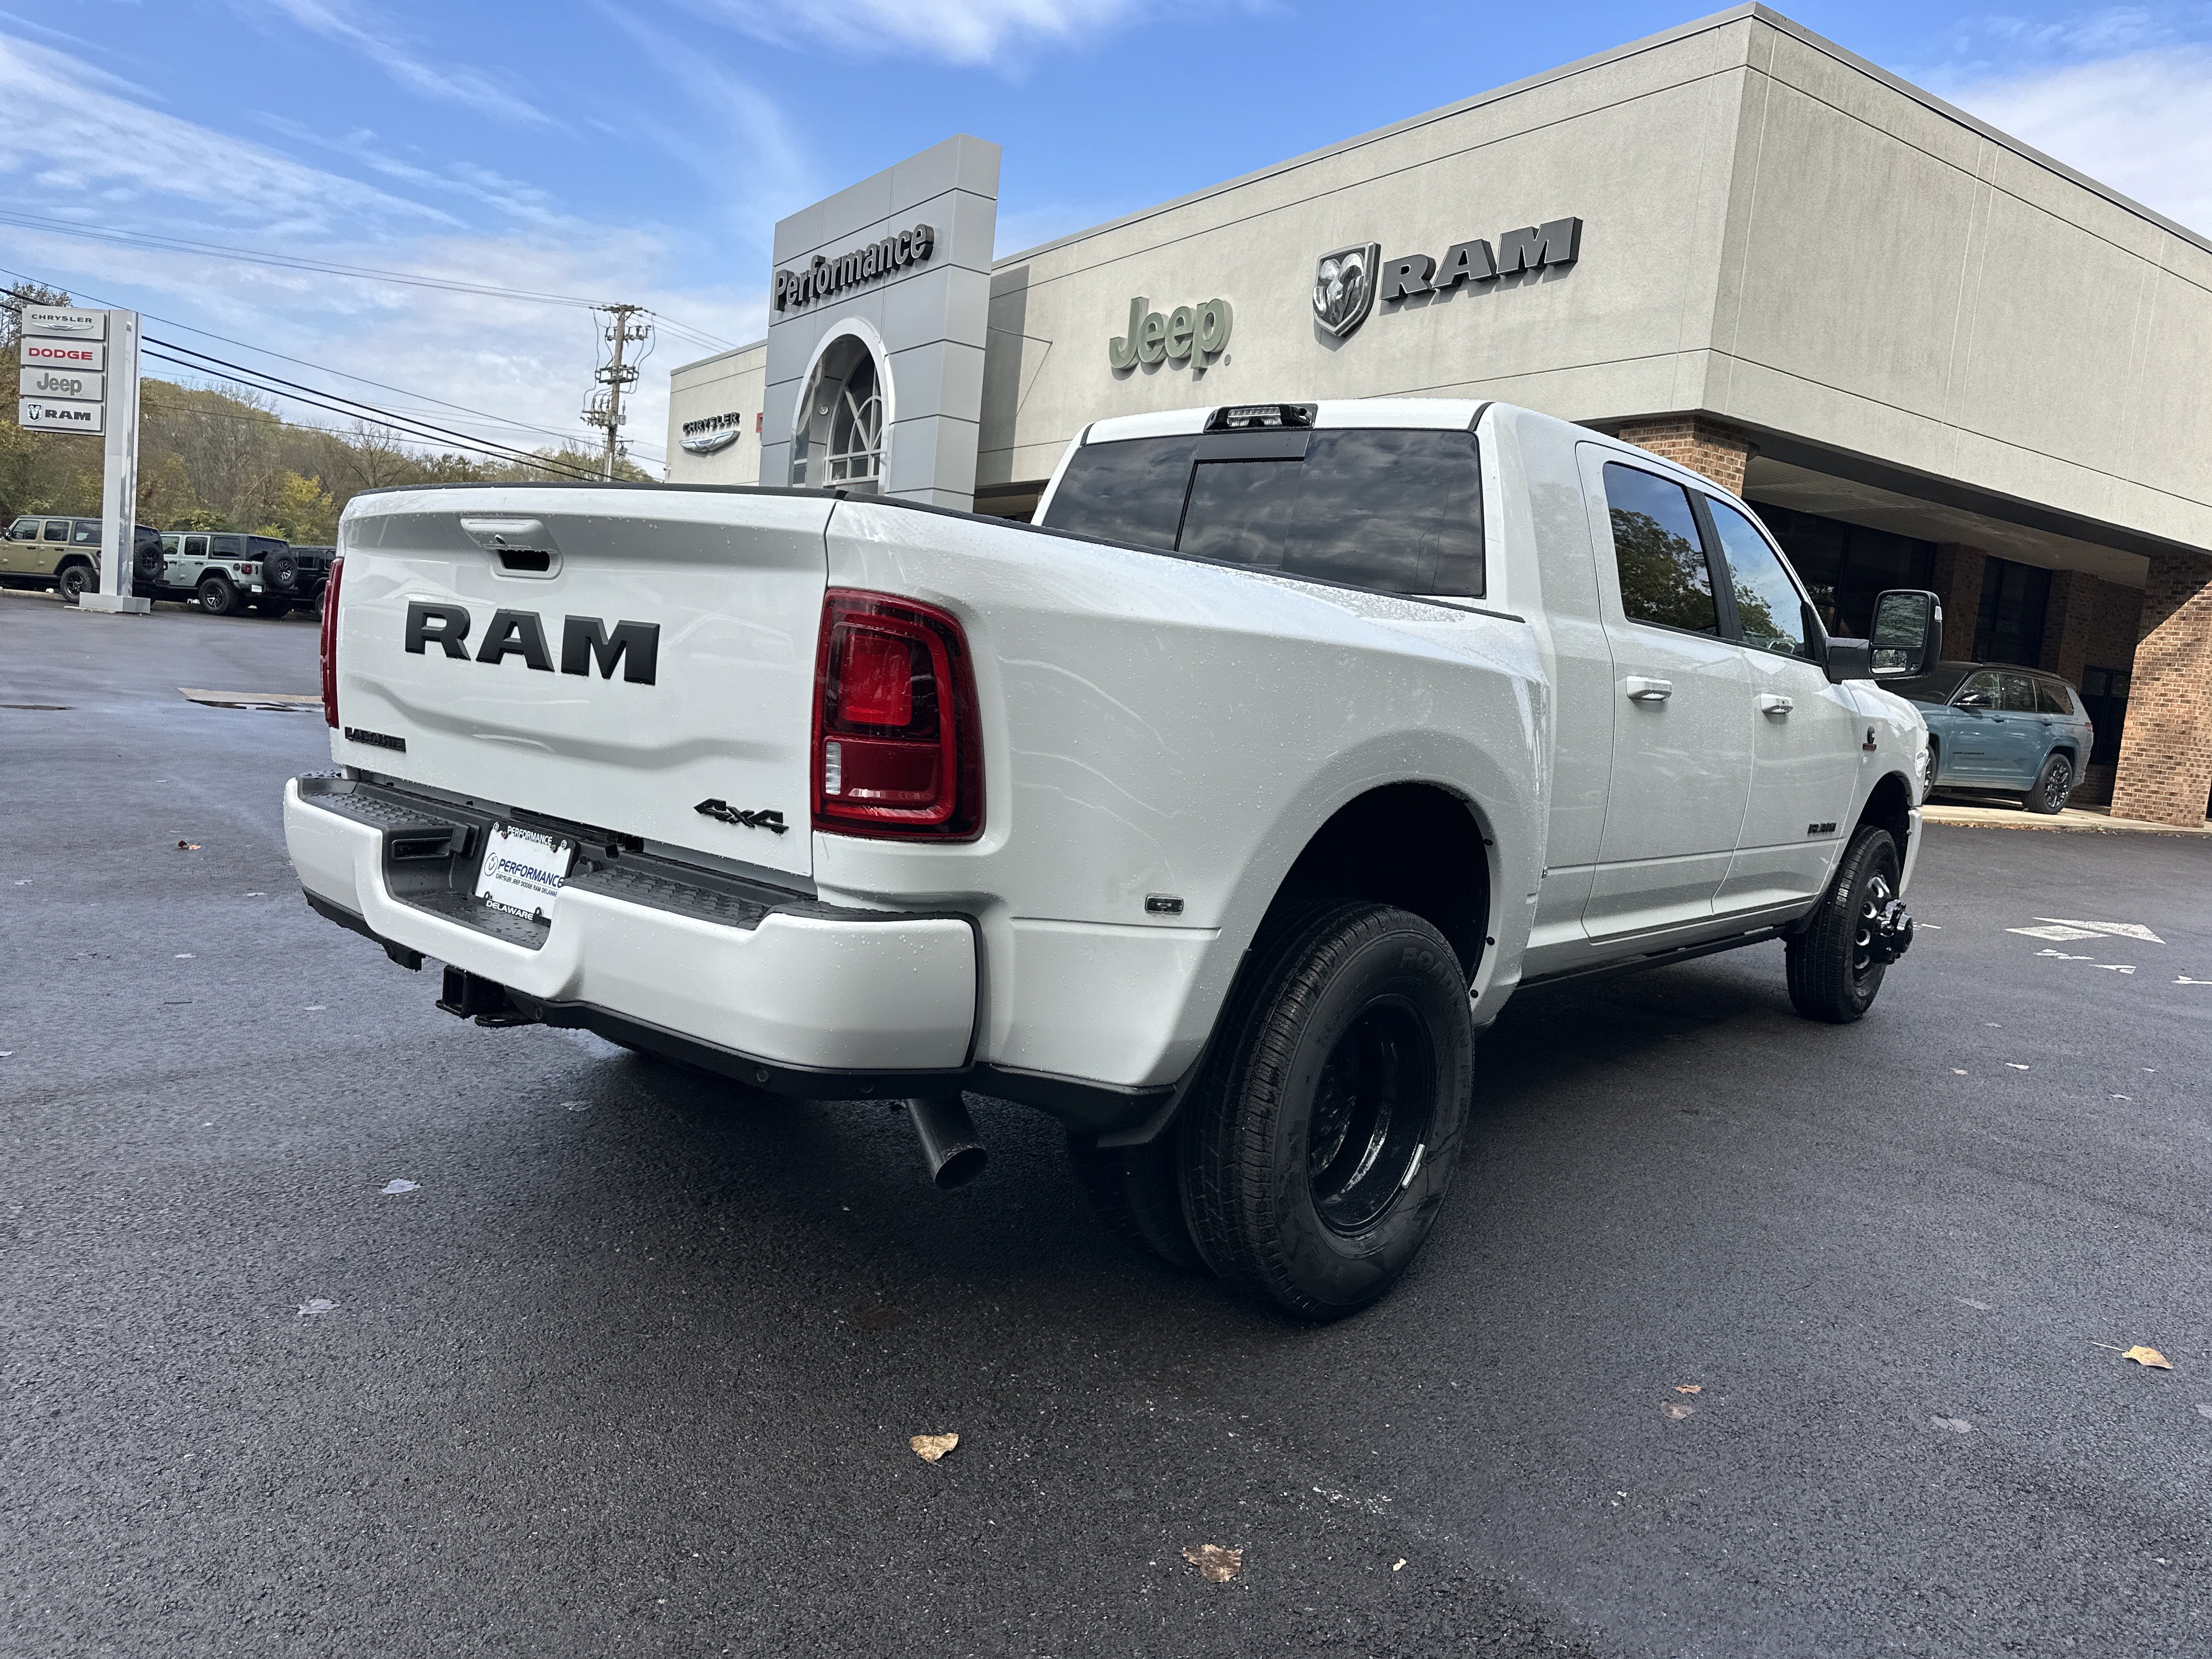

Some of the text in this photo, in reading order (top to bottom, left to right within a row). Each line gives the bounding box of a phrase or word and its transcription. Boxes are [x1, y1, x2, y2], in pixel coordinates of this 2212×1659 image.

[774, 223, 934, 311] Performance
[1379, 217, 1583, 301] RAM
[31, 314, 93, 323] CHRYSLER
[1109, 296, 1233, 369] Jeep
[29, 347, 93, 360] DODGE
[37, 373, 82, 396] Jeep
[45, 409, 91, 421] RAM
[682, 412, 740, 433] CHRYSLER
[405, 600, 660, 685] RAM
[507, 825, 552, 845] PERFORMANCE
[495, 873, 512, 883] CHRYSLER
[520, 881, 533, 890] DODGE
[498, 858, 564, 888] PERFORMANCE
[486, 900, 534, 921] DELAWARE
